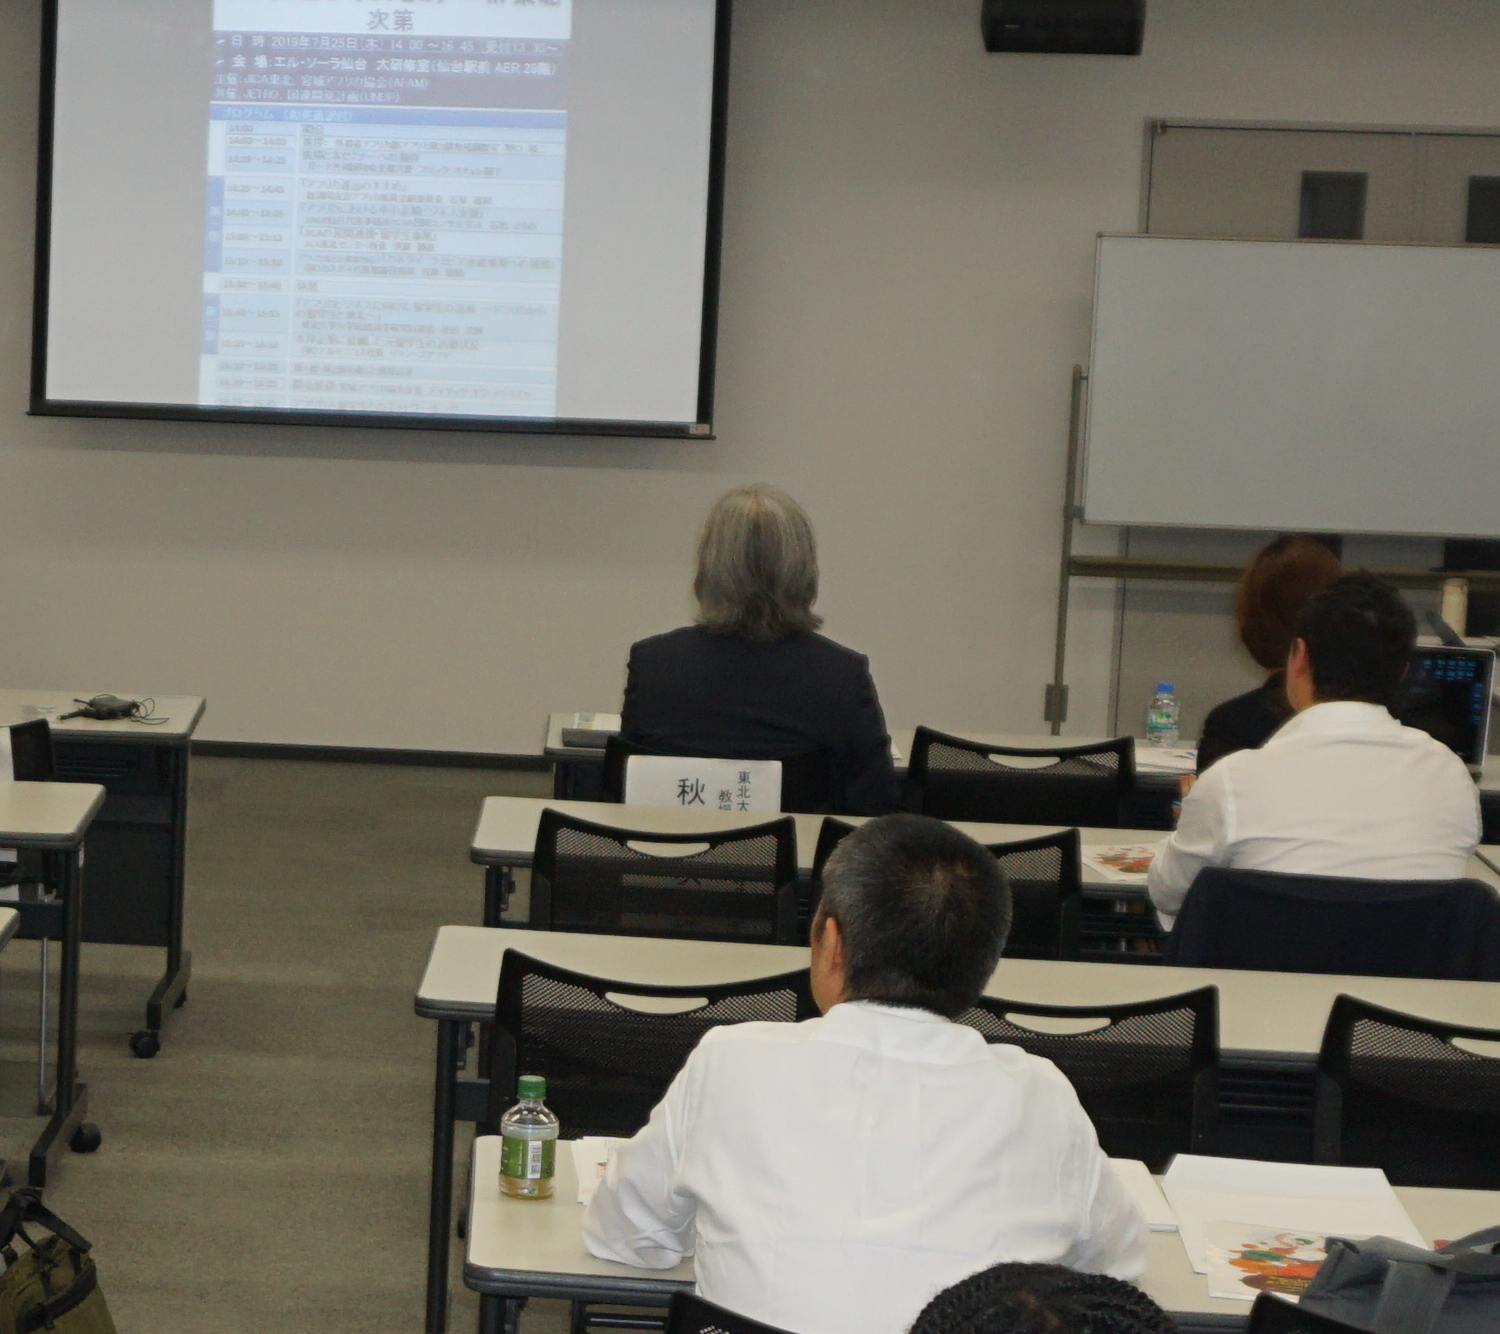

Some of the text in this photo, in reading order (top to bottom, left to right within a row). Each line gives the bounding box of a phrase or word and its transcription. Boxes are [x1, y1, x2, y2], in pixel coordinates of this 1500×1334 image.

[366, 8, 416, 32] 次第
[676, 777, 707, 806] 秋
[736, 770, 752, 812] 東北大
